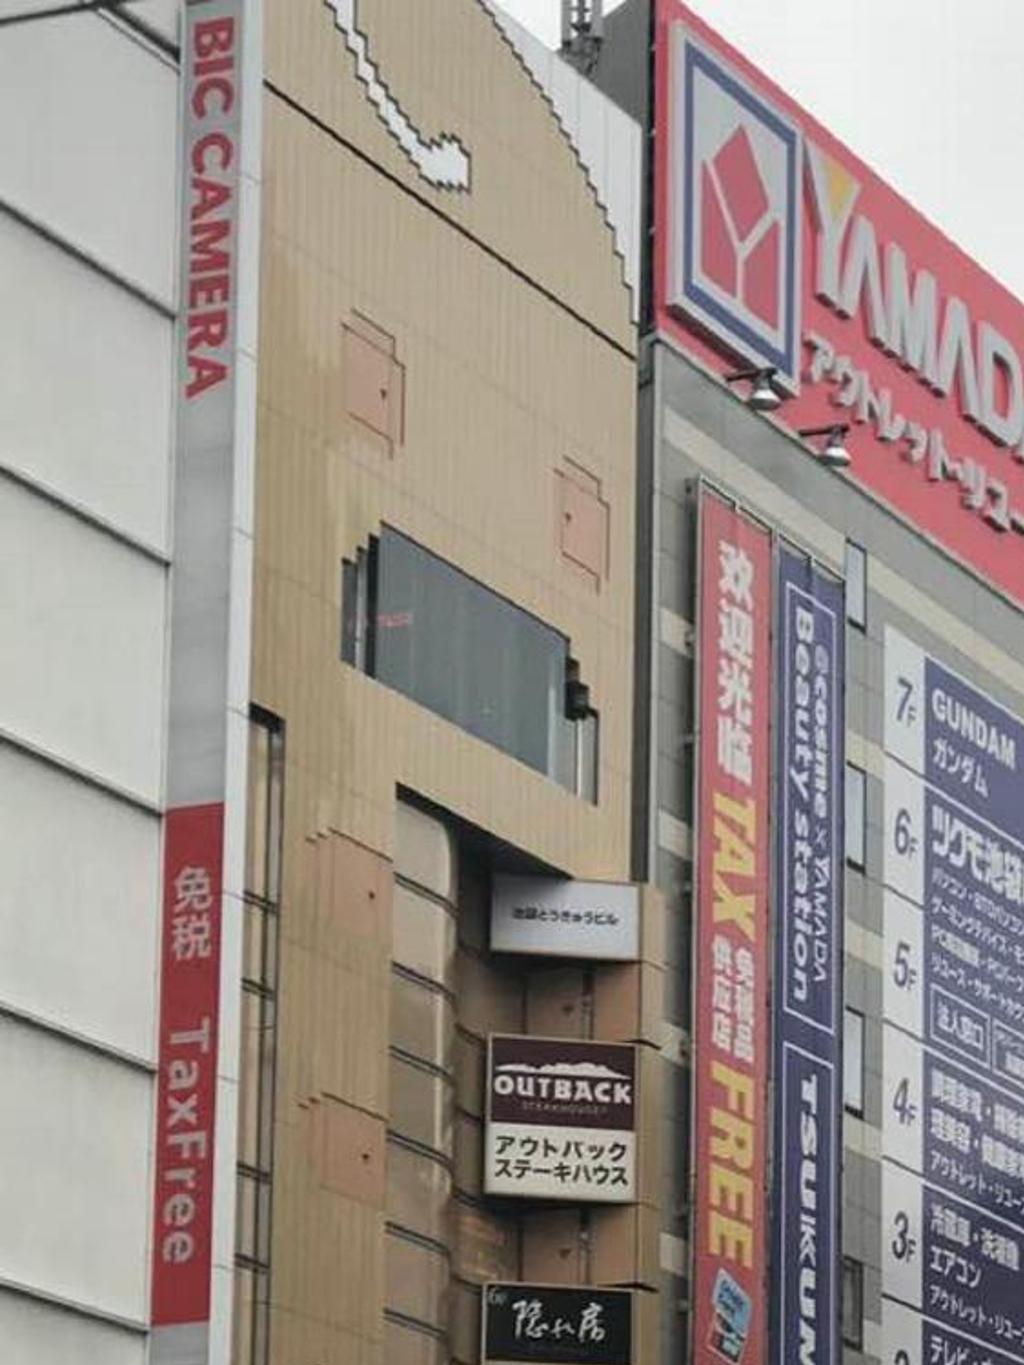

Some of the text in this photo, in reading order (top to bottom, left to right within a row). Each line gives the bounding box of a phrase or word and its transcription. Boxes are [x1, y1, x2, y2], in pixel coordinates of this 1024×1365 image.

[184, 16, 235, 400] BIC CAMERA
[896, 676, 917, 728] 7F
[931, 688, 1017, 770] GUNDAM
[932, 737, 989, 799] ガンダム
[789, 605, 816, 1001] Beauty station
[894, 808, 919, 859] 6F
[713, 792, 757, 943] TAX
[893, 940, 918, 991] 5F
[493, 1073, 633, 1105] OUTBACK
[893, 1077, 918, 1127] 4F
[494, 1134, 628, 1163] アウトバック
[494, 1157, 629, 1187] ステーキハウス
[708, 1060, 757, 1270] FREE
[892, 1210, 917, 1263] 3F
[930, 1244, 983, 1289] エアコン
